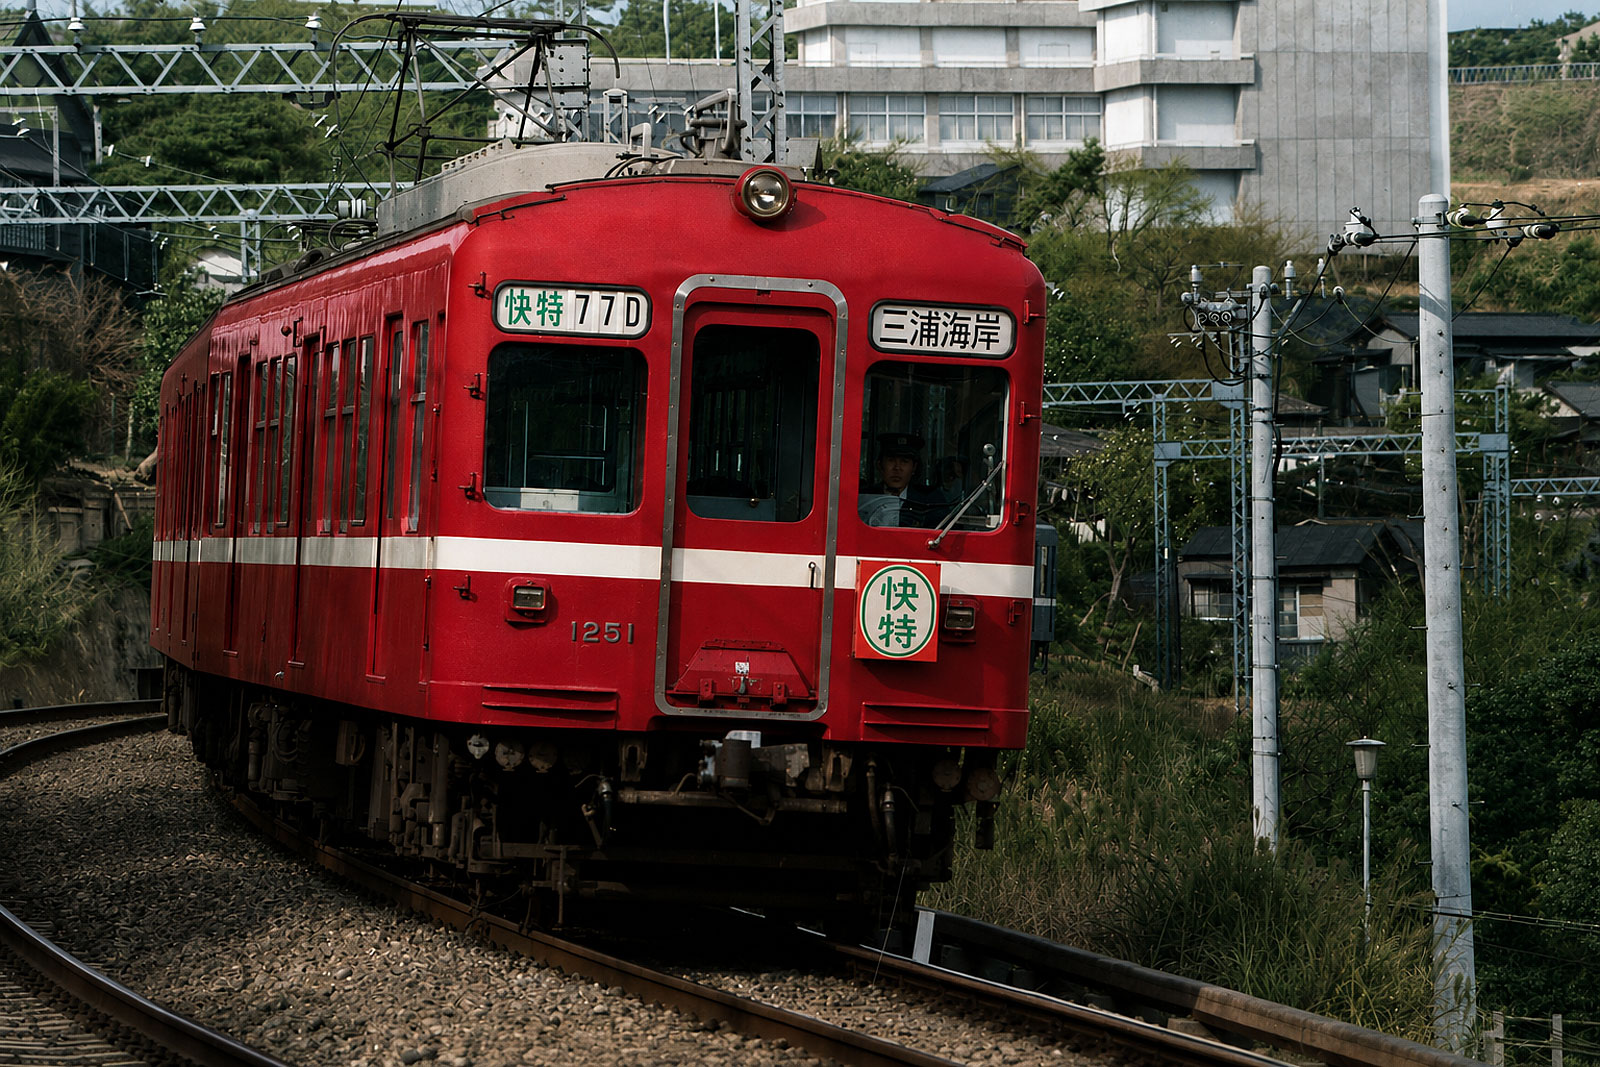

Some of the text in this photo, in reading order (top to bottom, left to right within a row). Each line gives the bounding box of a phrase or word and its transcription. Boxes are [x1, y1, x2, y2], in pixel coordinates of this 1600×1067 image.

[504, 288, 564, 327] 快特
[879, 309, 1001, 351] 三浦海岸
[571, 621, 634, 644] 1251
[878, 576, 919, 649] 快特
